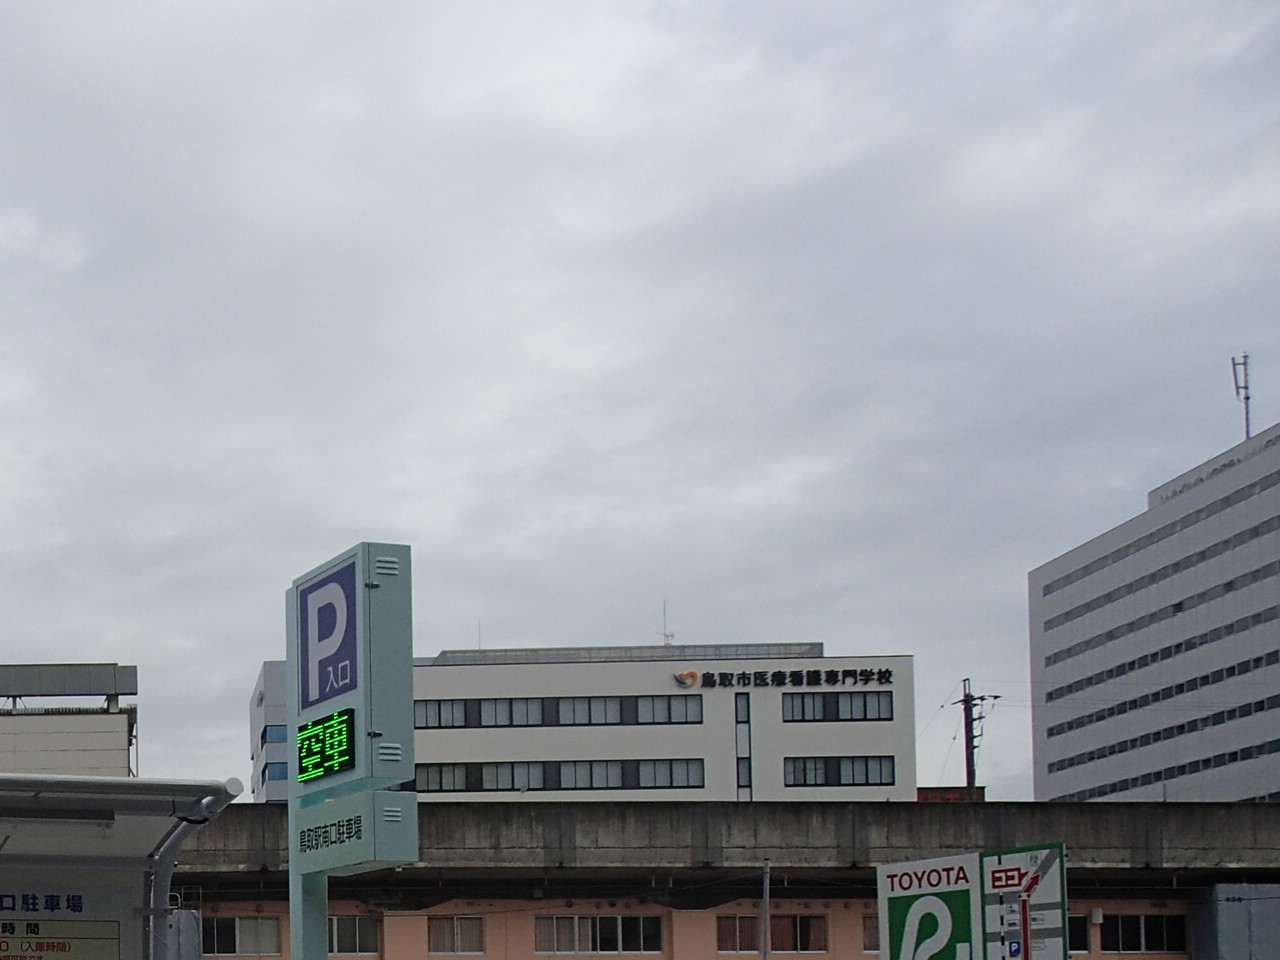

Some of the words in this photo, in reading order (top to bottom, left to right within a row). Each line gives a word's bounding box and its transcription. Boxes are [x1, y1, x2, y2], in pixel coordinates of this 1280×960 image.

[307, 582, 347, 702] P
[325, 660, 350, 694] 入口
[701, 667, 893, 688] 鳥取市医療看護専門学校
[297, 712, 349, 783] 空車
[299, 815, 362, 853] 鳥取駅南口駐車場
[886, 866, 969, 892] TOYOTA
[994, 872, 1019, 886] ココ
